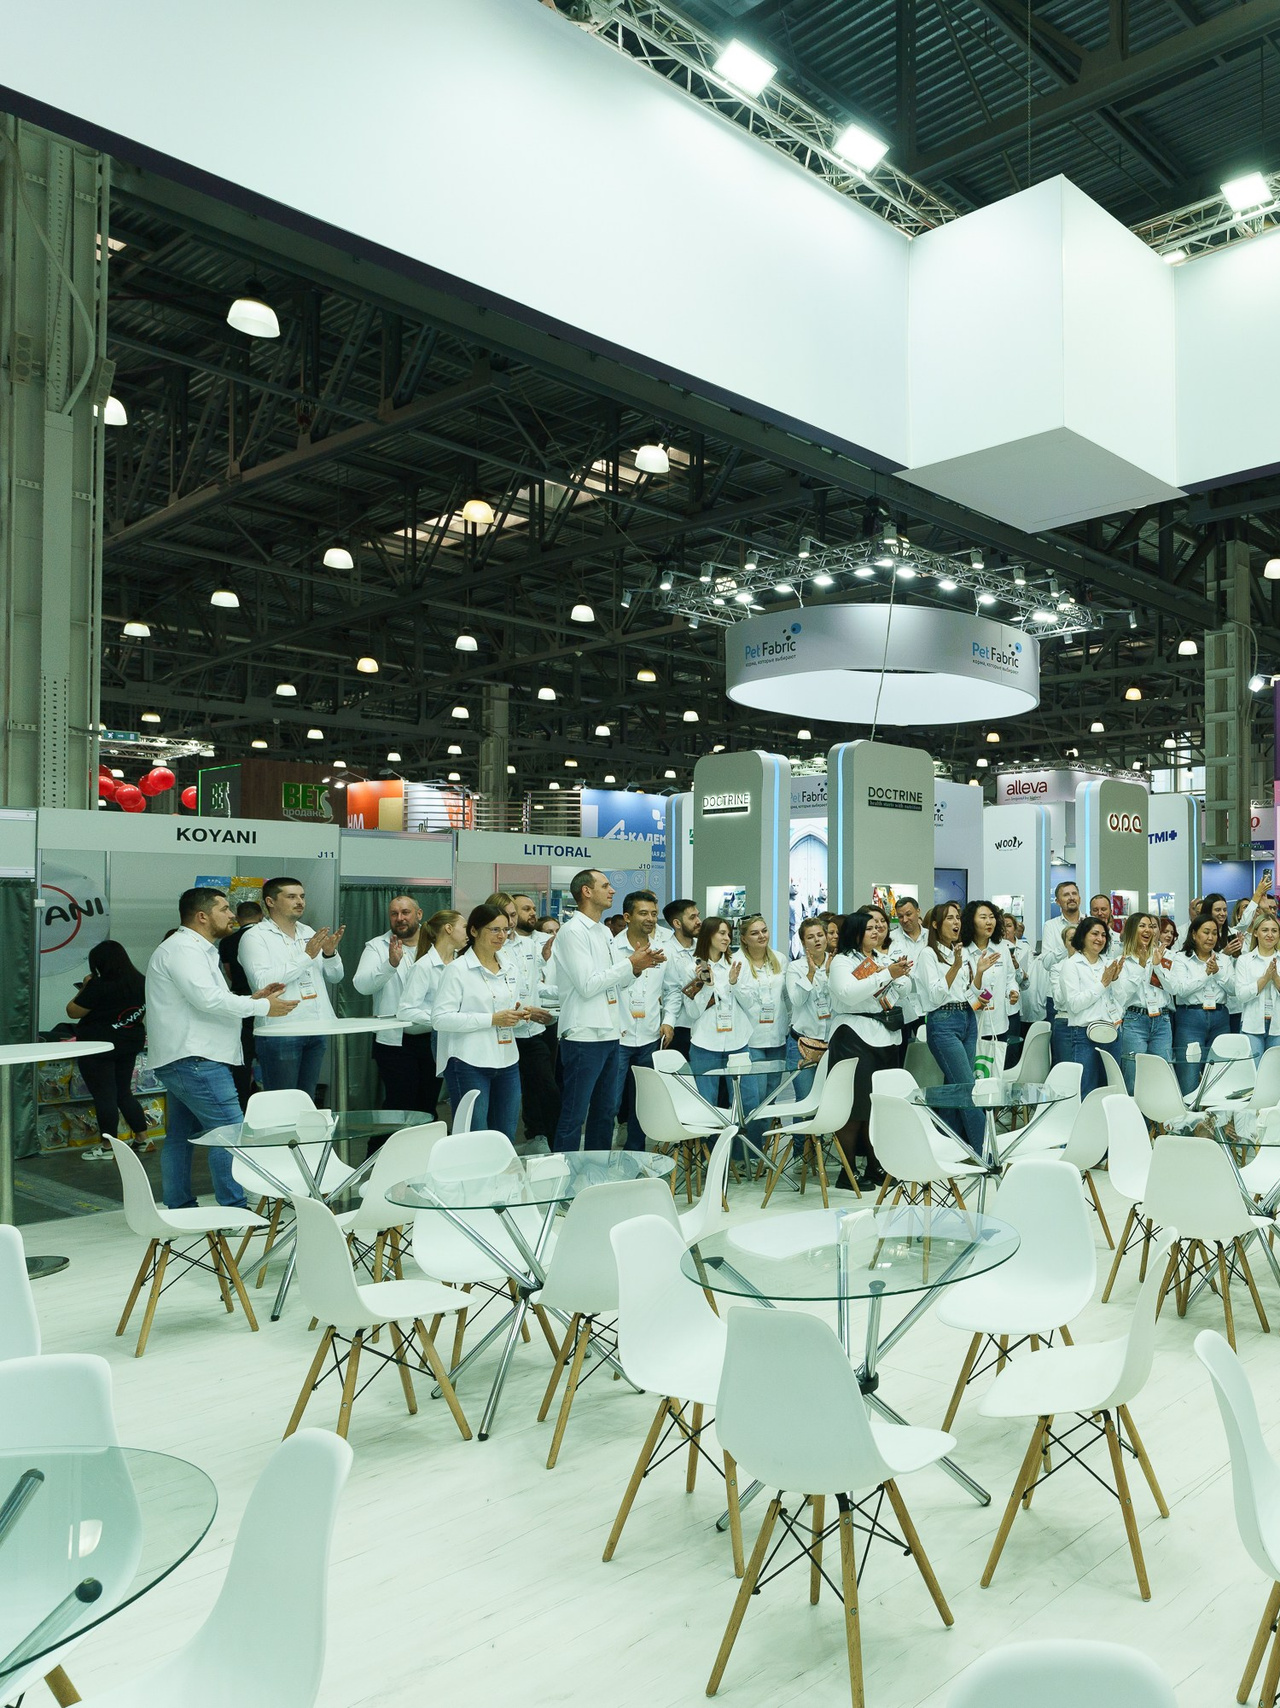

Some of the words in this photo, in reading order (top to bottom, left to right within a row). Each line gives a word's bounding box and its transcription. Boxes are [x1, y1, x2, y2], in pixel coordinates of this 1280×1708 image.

[868, 786, 923, 803] DOCTRINE
[1006, 780, 1048, 796] alleva
[703, 793, 749, 807] DOCTRINE
[176, 827, 257, 844] KOYANI
[524, 843, 592, 858] LITTORAL
[45, 897, 104, 926] ANI
